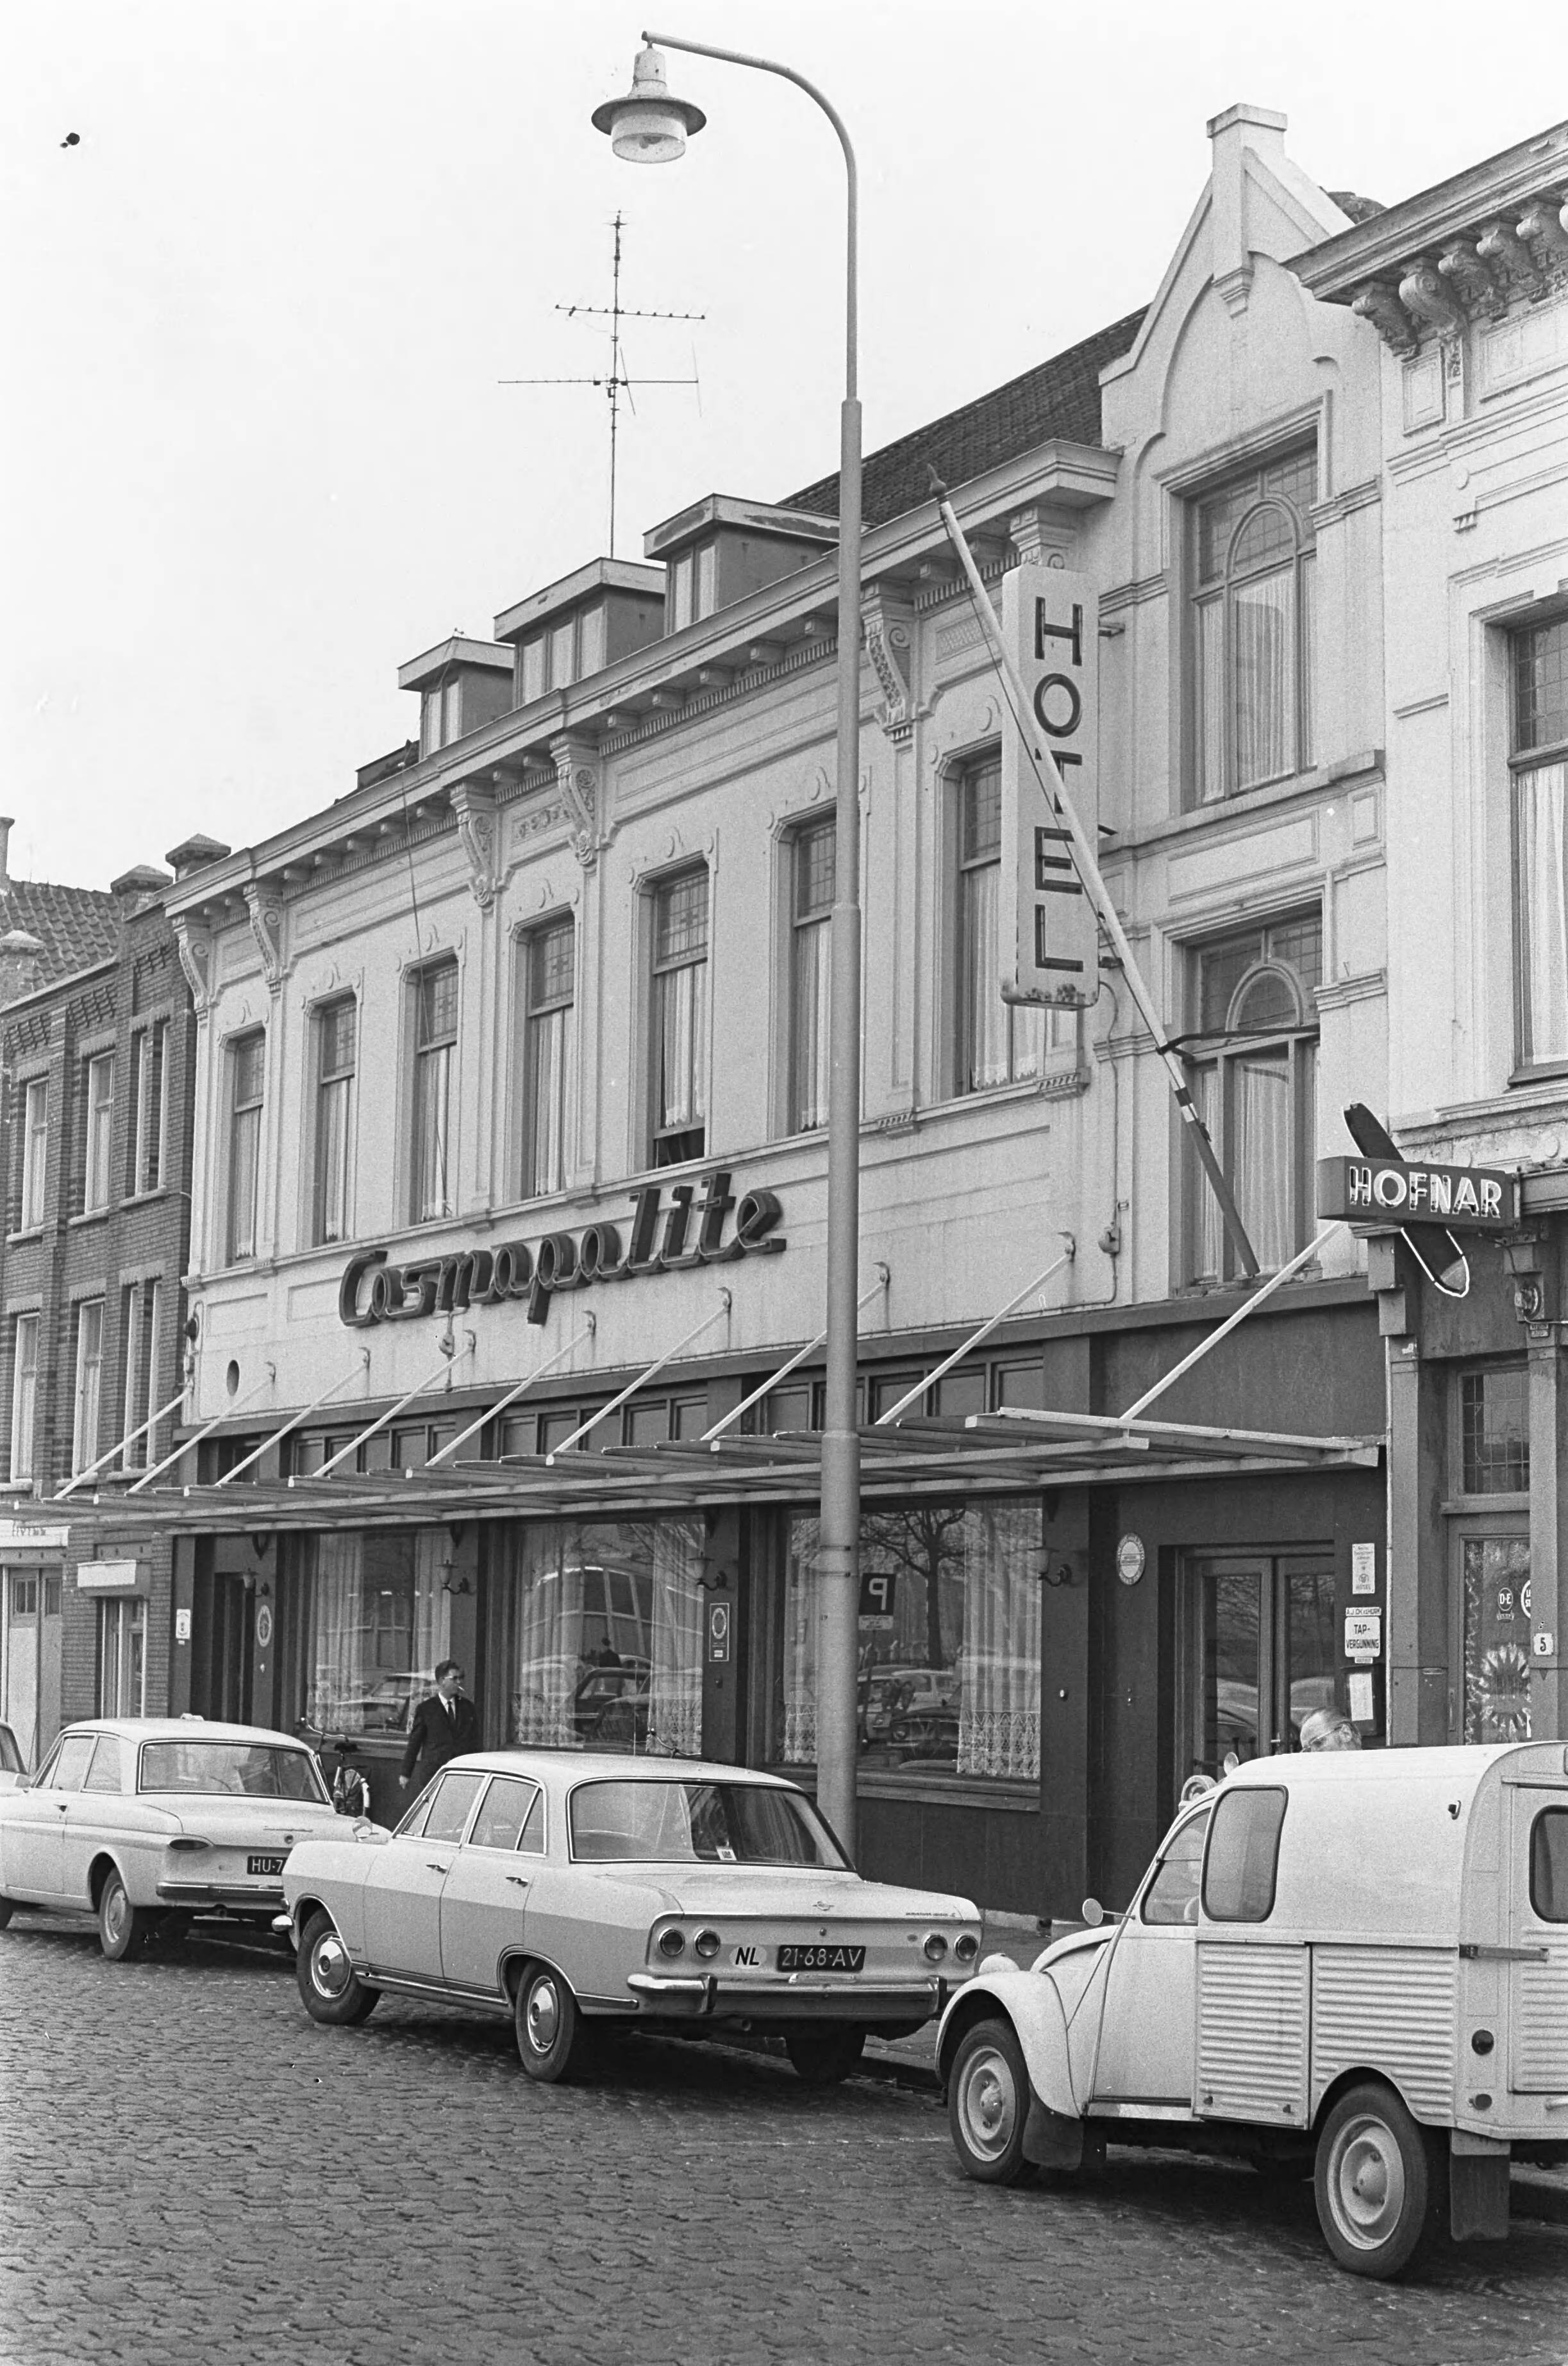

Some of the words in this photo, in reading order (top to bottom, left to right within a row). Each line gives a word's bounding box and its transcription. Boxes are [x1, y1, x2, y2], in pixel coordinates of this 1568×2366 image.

[1033, 596, 1084, 973] HOTEL
[1349, 1165, 1502, 1219] HOFNAR
[339, 1172, 787, 1328] Cosmopolite
[1499, 1593, 1512, 1604] D-E
[1354, 1624, 1371, 1635] TAP-
[1346, 1638, 1379, 1649] VERGUNNING
[1540, 1637, 1547, 1653] 5
[735, 1946, 760, 1966] NL
